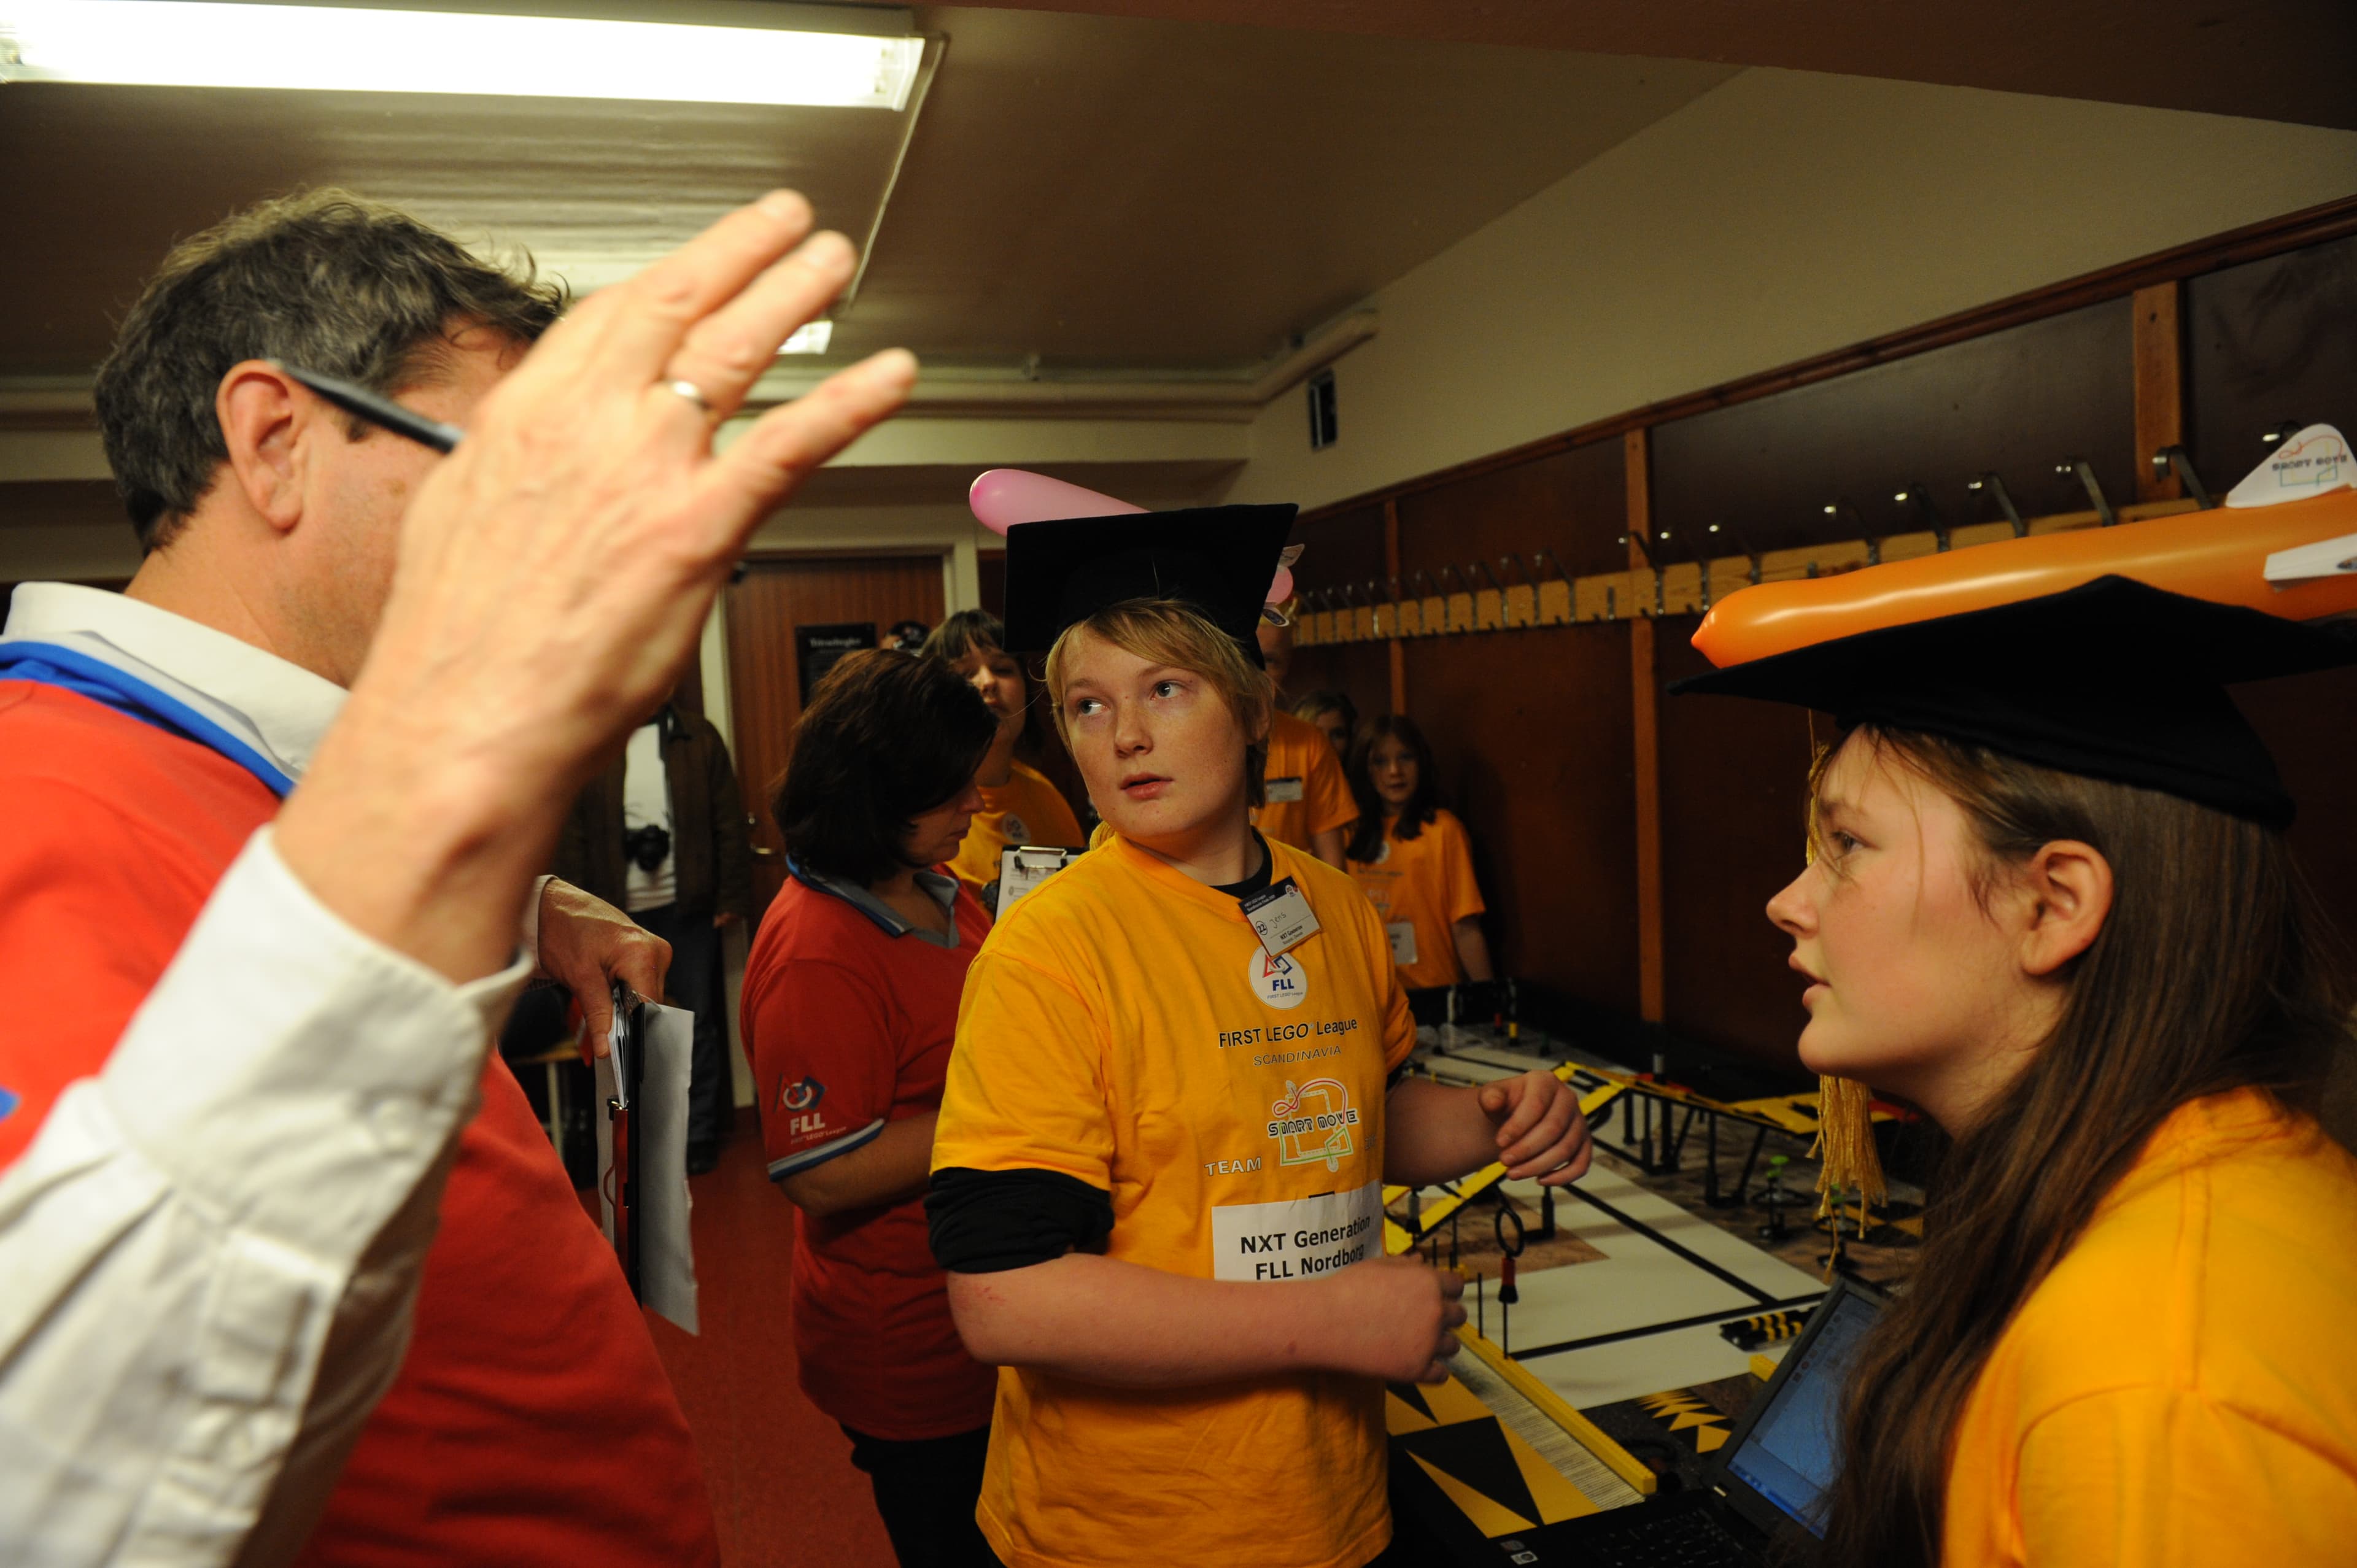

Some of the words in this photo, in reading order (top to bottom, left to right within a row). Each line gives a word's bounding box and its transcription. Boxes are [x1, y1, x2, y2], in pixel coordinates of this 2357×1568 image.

[1272, 979, 1294, 991] FLL
[1219, 1029, 1261, 1048] FIRST
[1266, 1023, 1309, 1041] LEGO
[1317, 1019, 1357, 1035] League
[1253, 1046, 1341, 1066] SCANDINAVIA
[790, 1113, 825, 1135] FLL
[1268, 1118, 1312, 1136] SMART
[1317, 1110, 1358, 1129] MOVE
[1205, 1157, 1262, 1176] TEAM
[1240, 1233, 1286, 1253] NXT
[1294, 1216, 1370, 1248] Generation
[1256, 1261, 1293, 1280] FLL
[1301, 1244, 1364, 1275] Nordborg
